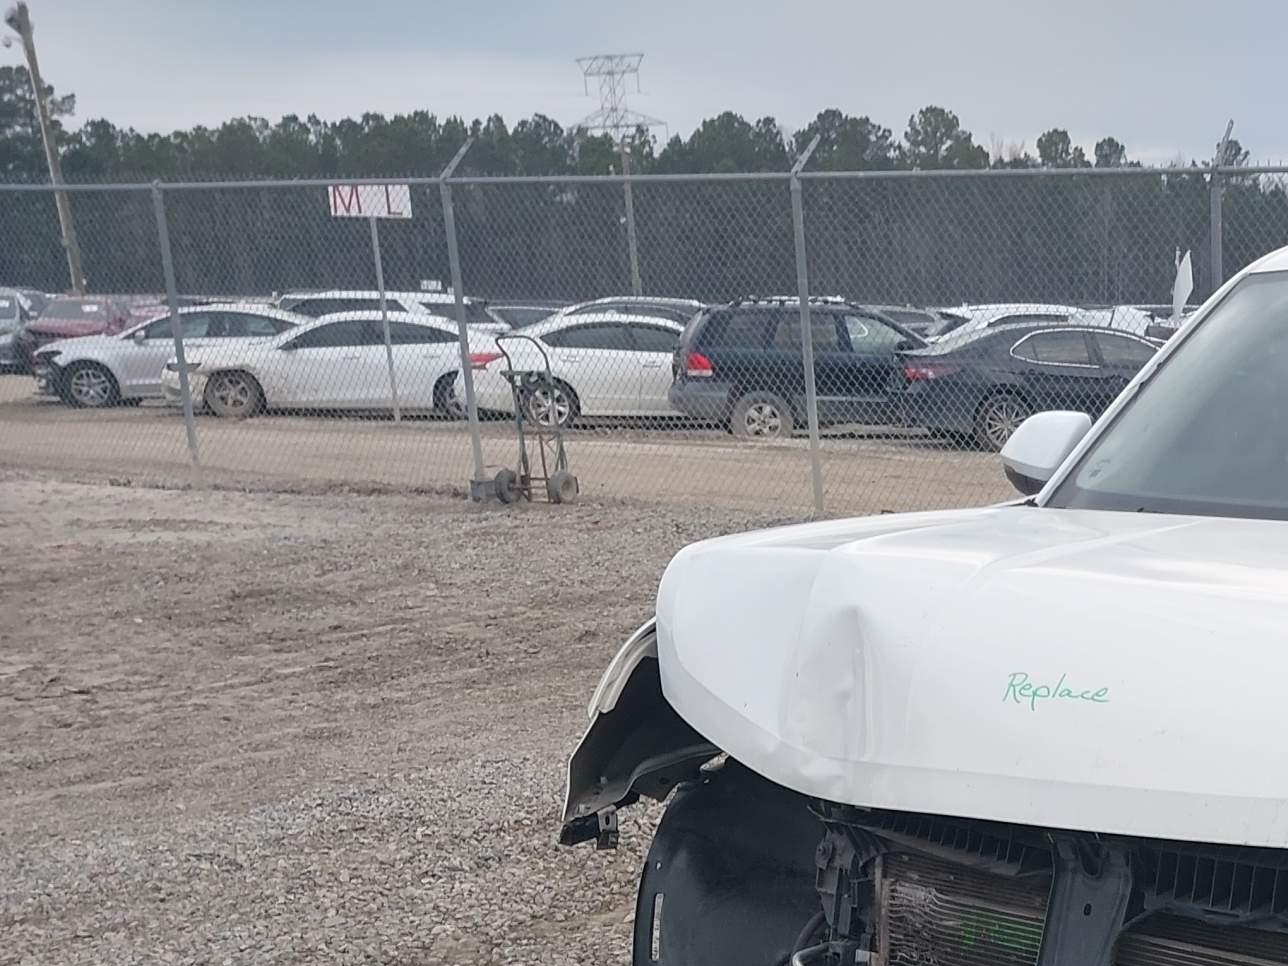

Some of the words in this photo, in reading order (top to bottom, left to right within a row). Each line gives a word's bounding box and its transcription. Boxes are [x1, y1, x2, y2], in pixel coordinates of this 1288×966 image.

[332, 185, 362, 214] M
[384, 185, 403, 215] L
[1002, 672, 1110, 711] Replace
